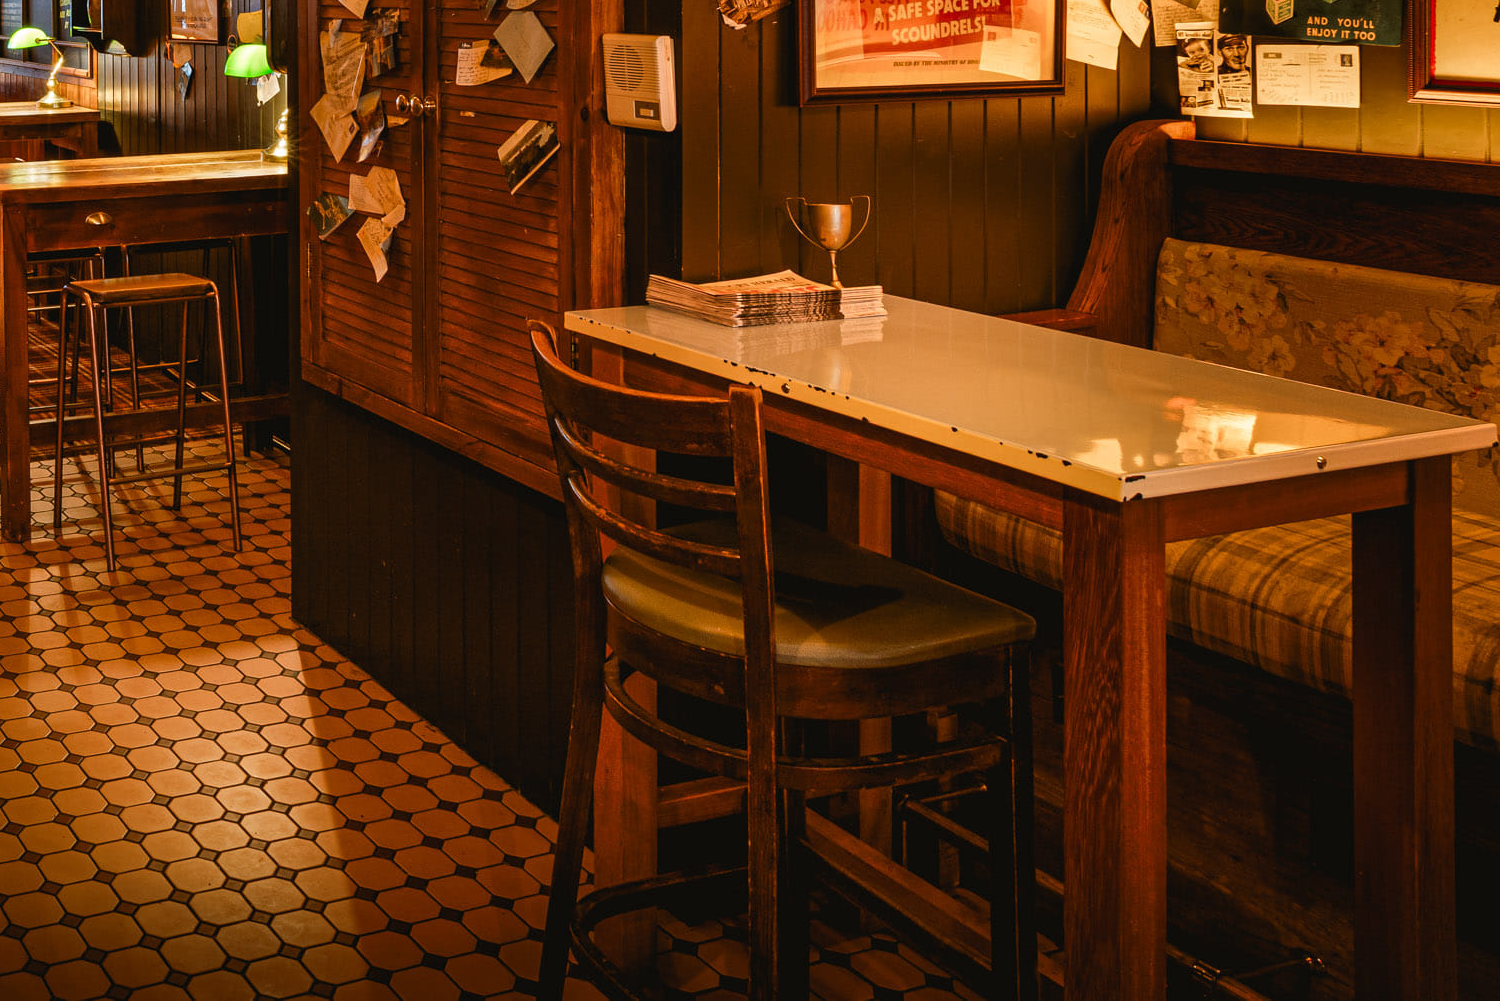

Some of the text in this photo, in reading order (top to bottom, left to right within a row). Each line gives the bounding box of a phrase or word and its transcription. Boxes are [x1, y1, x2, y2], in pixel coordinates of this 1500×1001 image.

[873, 7, 885, 24] A
[888, 1, 923, 22] SAFE
[892, 17, 987, 46] SCOUNDRELS!
[1307, 16, 1376, 30] AND YOU'LL
[1306, 27, 1376, 41] ENJOY IT TOO
